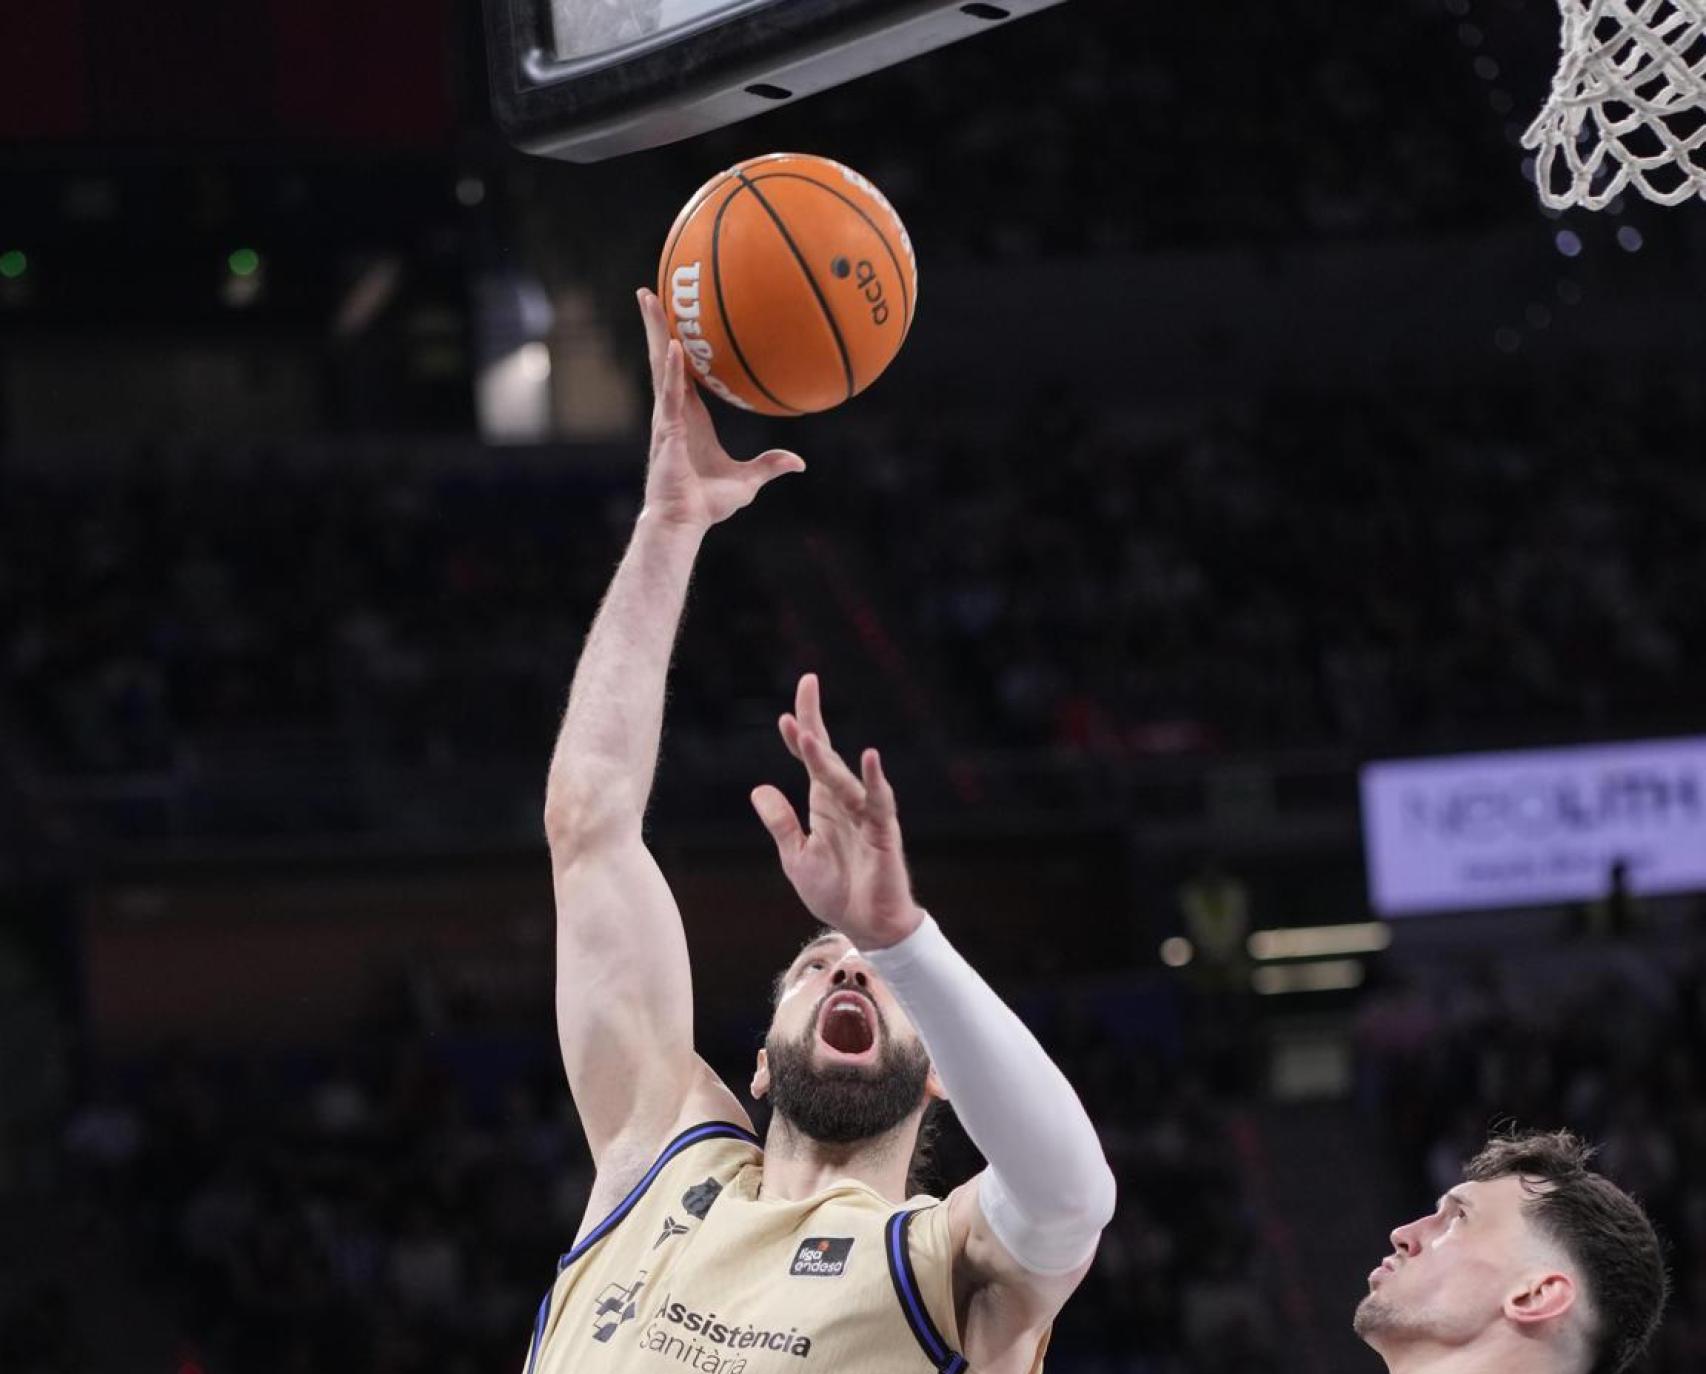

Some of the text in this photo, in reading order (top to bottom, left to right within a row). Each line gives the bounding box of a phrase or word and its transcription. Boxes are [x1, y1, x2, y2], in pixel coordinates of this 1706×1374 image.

[855, 261, 888, 326] acb
[794, 1259, 843, 1273] endesa
[800, 1247, 823, 1261] liga
[655, 1293, 812, 1359] Assistència
